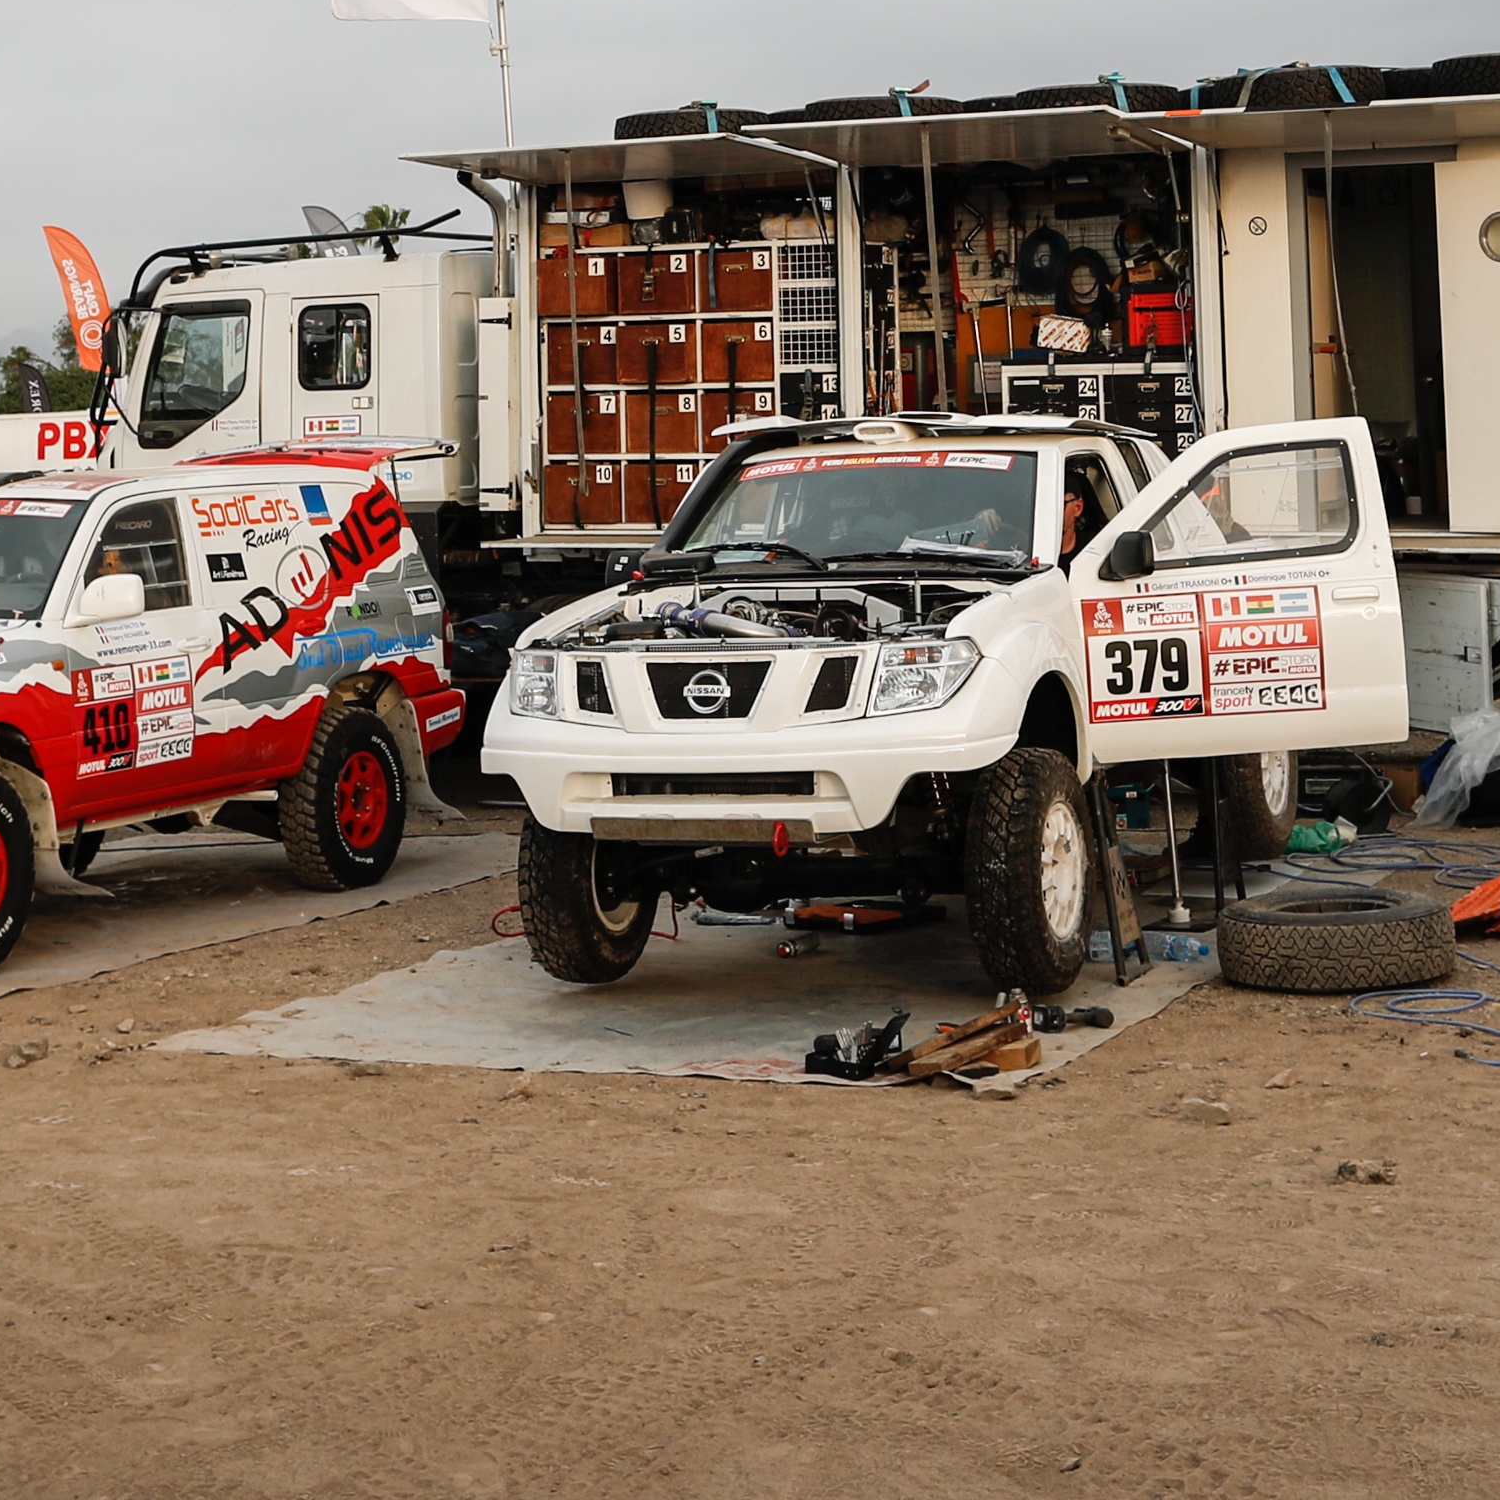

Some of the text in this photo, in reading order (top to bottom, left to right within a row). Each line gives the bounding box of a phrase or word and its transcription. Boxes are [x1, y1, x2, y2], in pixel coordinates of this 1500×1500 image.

[674, 257, 683, 270] 2
[757, 254, 765, 267] 3
[592, 261, 598, 275] 1
[603, 329, 612, 342] 4
[673, 327, 682, 340] 5
[759, 325, 767, 338] 6
[823, 377, 837, 391] 13
[1079, 380, 1097, 395] 24
[1176, 379, 1192, 393] 25
[604, 398, 612, 411] 7
[683, 396, 691, 409] 8
[758, 395, 767, 408] 9
[1080, 408, 1095, 420] 26
[1176, 407, 1193, 421] 27
[1178, 435, 1195, 449] 29
[677, 466, 690, 480] 11
[746, 462, 795, 478] MOTUL
[822, 458, 843, 467] PERU
[843, 457, 875, 466] BOLIVIA
[875, 455, 921, 464] ARGENTINA
[597, 467, 611, 481] 10
[192, 495, 299, 528] SodiCars
[116, 520, 152, 530] RECARO
[242, 526, 290, 551] Racing
[1248, 573, 1287, 583] Dominique
[1288, 570, 1317, 580] TOTAIN
[1151, 577, 1232, 592] Gérard TRAMONI O+
[1138, 613, 1193, 626] by MOTUL
[1218, 623, 1308, 647] MOTUL
[97, 640, 172, 657] www.remorque-33.com
[1105, 638, 1189, 695] 379
[1289, 666, 1317, 674] MOTUL
[687, 687, 724, 695] NISSAN
[1213, 686, 1254, 696] francetv
[1259, 683, 1318, 706] 2340
[141, 687, 187, 711] MOTUL
[1215, 695, 1253, 709] sport
[1096, 698, 1199, 717] MOTUL 300V
[84, 702, 130, 754] 410
[139, 750, 158, 763] sport
[79, 759, 106, 775] MOTUL
